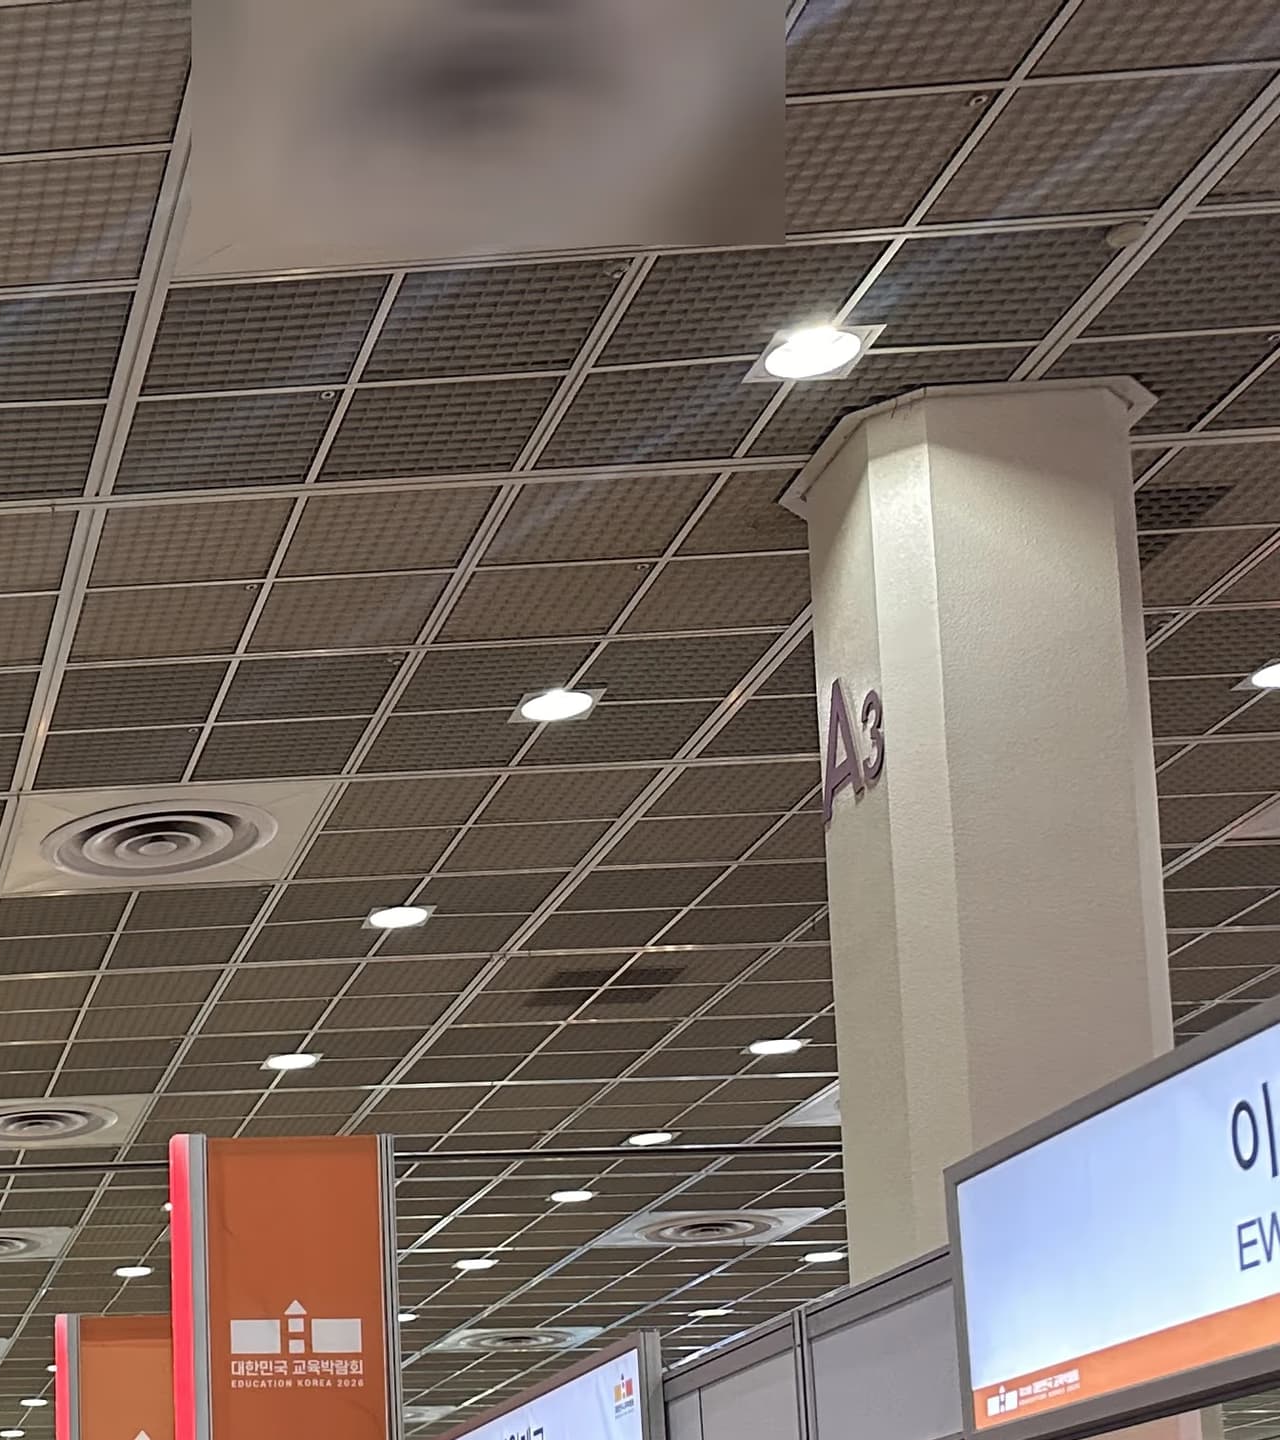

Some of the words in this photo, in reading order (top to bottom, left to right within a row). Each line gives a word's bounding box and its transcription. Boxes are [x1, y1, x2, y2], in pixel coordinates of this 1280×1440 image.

[823, 677, 885, 828] A3
[1232, 1081, 1279, 1178] 이
[1237, 1212, 1280, 1272] EW
[231, 1360, 289, 1376] 대한민국
[292, 1360, 364, 1376] 교육박람회
[231, 1380, 292, 1388] EDUCATION
[297, 1380, 332, 1388] KOREA
[337, 1379, 364, 1387] 2026
